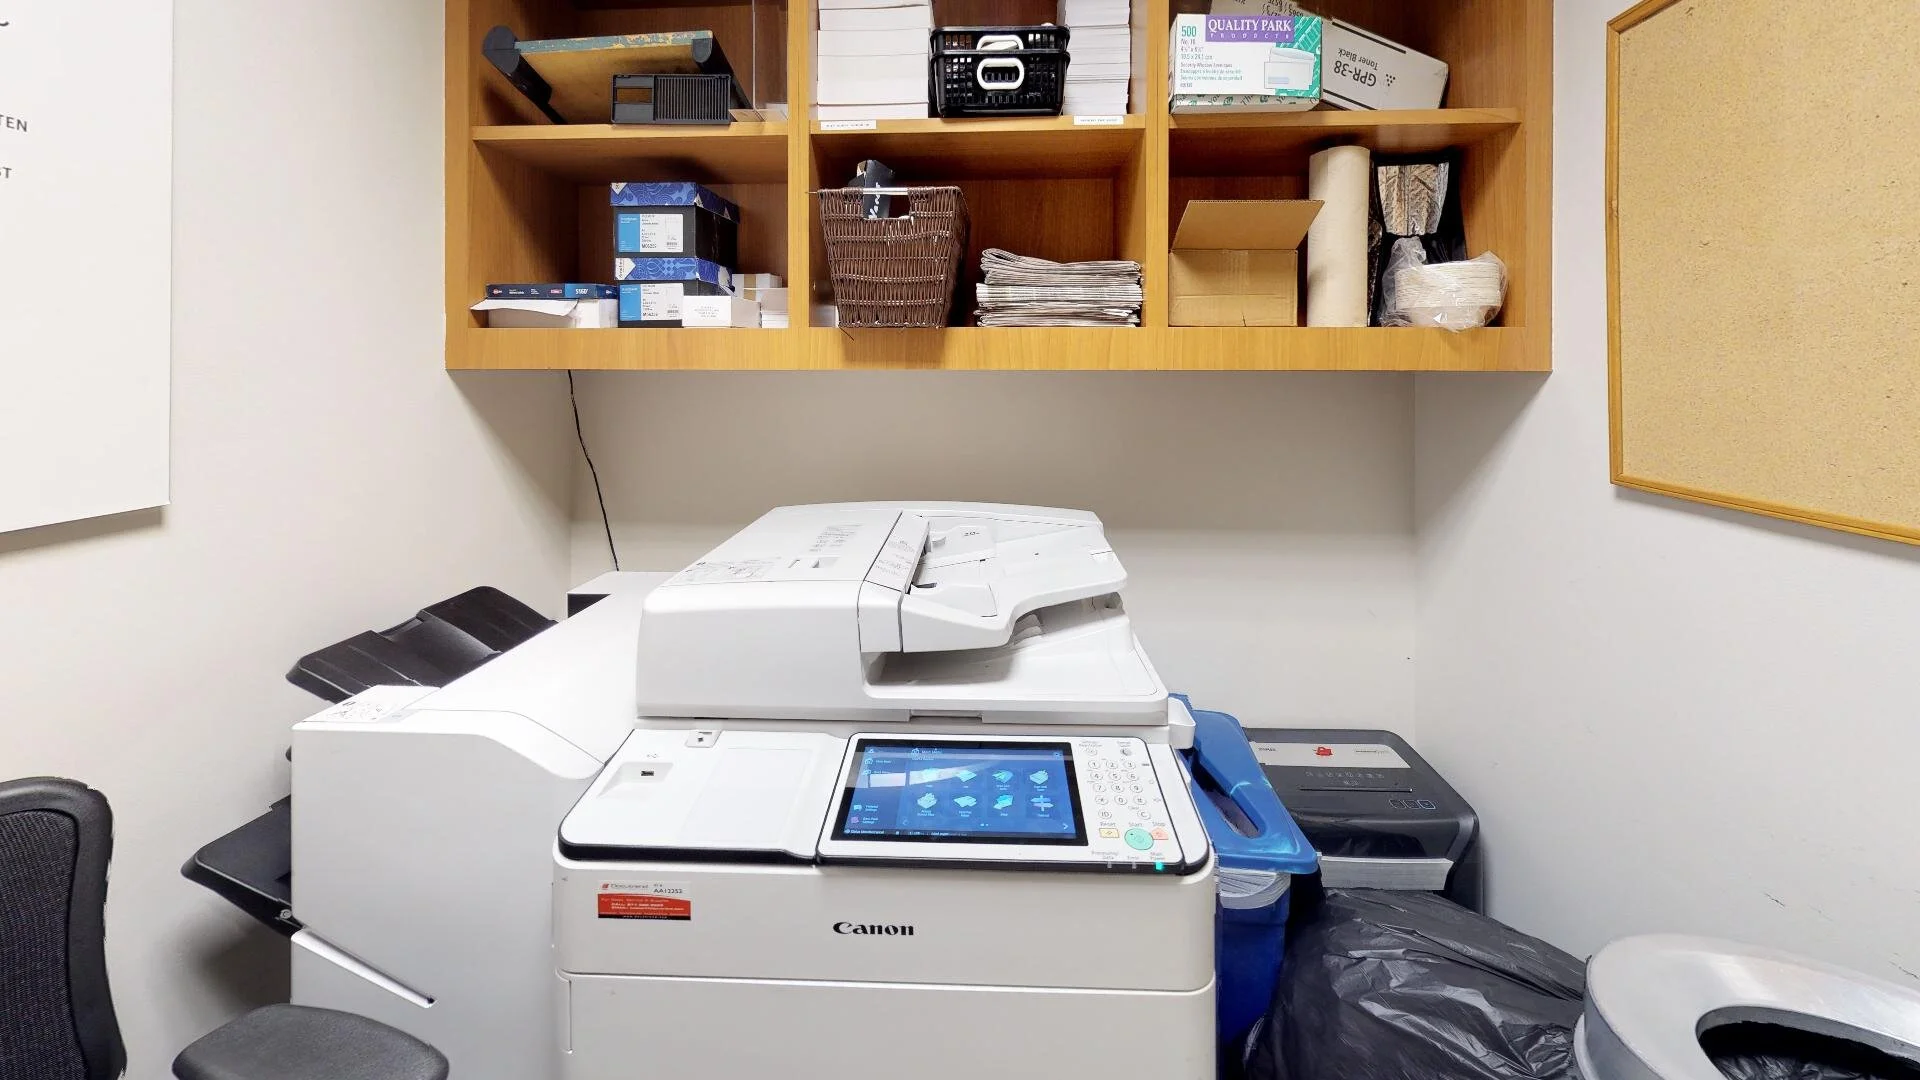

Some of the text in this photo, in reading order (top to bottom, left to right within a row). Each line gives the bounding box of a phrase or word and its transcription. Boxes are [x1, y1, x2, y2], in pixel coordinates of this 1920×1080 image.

[1181, 25, 1197, 37] 500
[1208, 18, 1292, 32] QUALITY PARK
[1338, 47, 1379, 71] Toner Black
[1333, 60, 1377, 87] GPR-38
[832, 921, 914, 936] Canon
